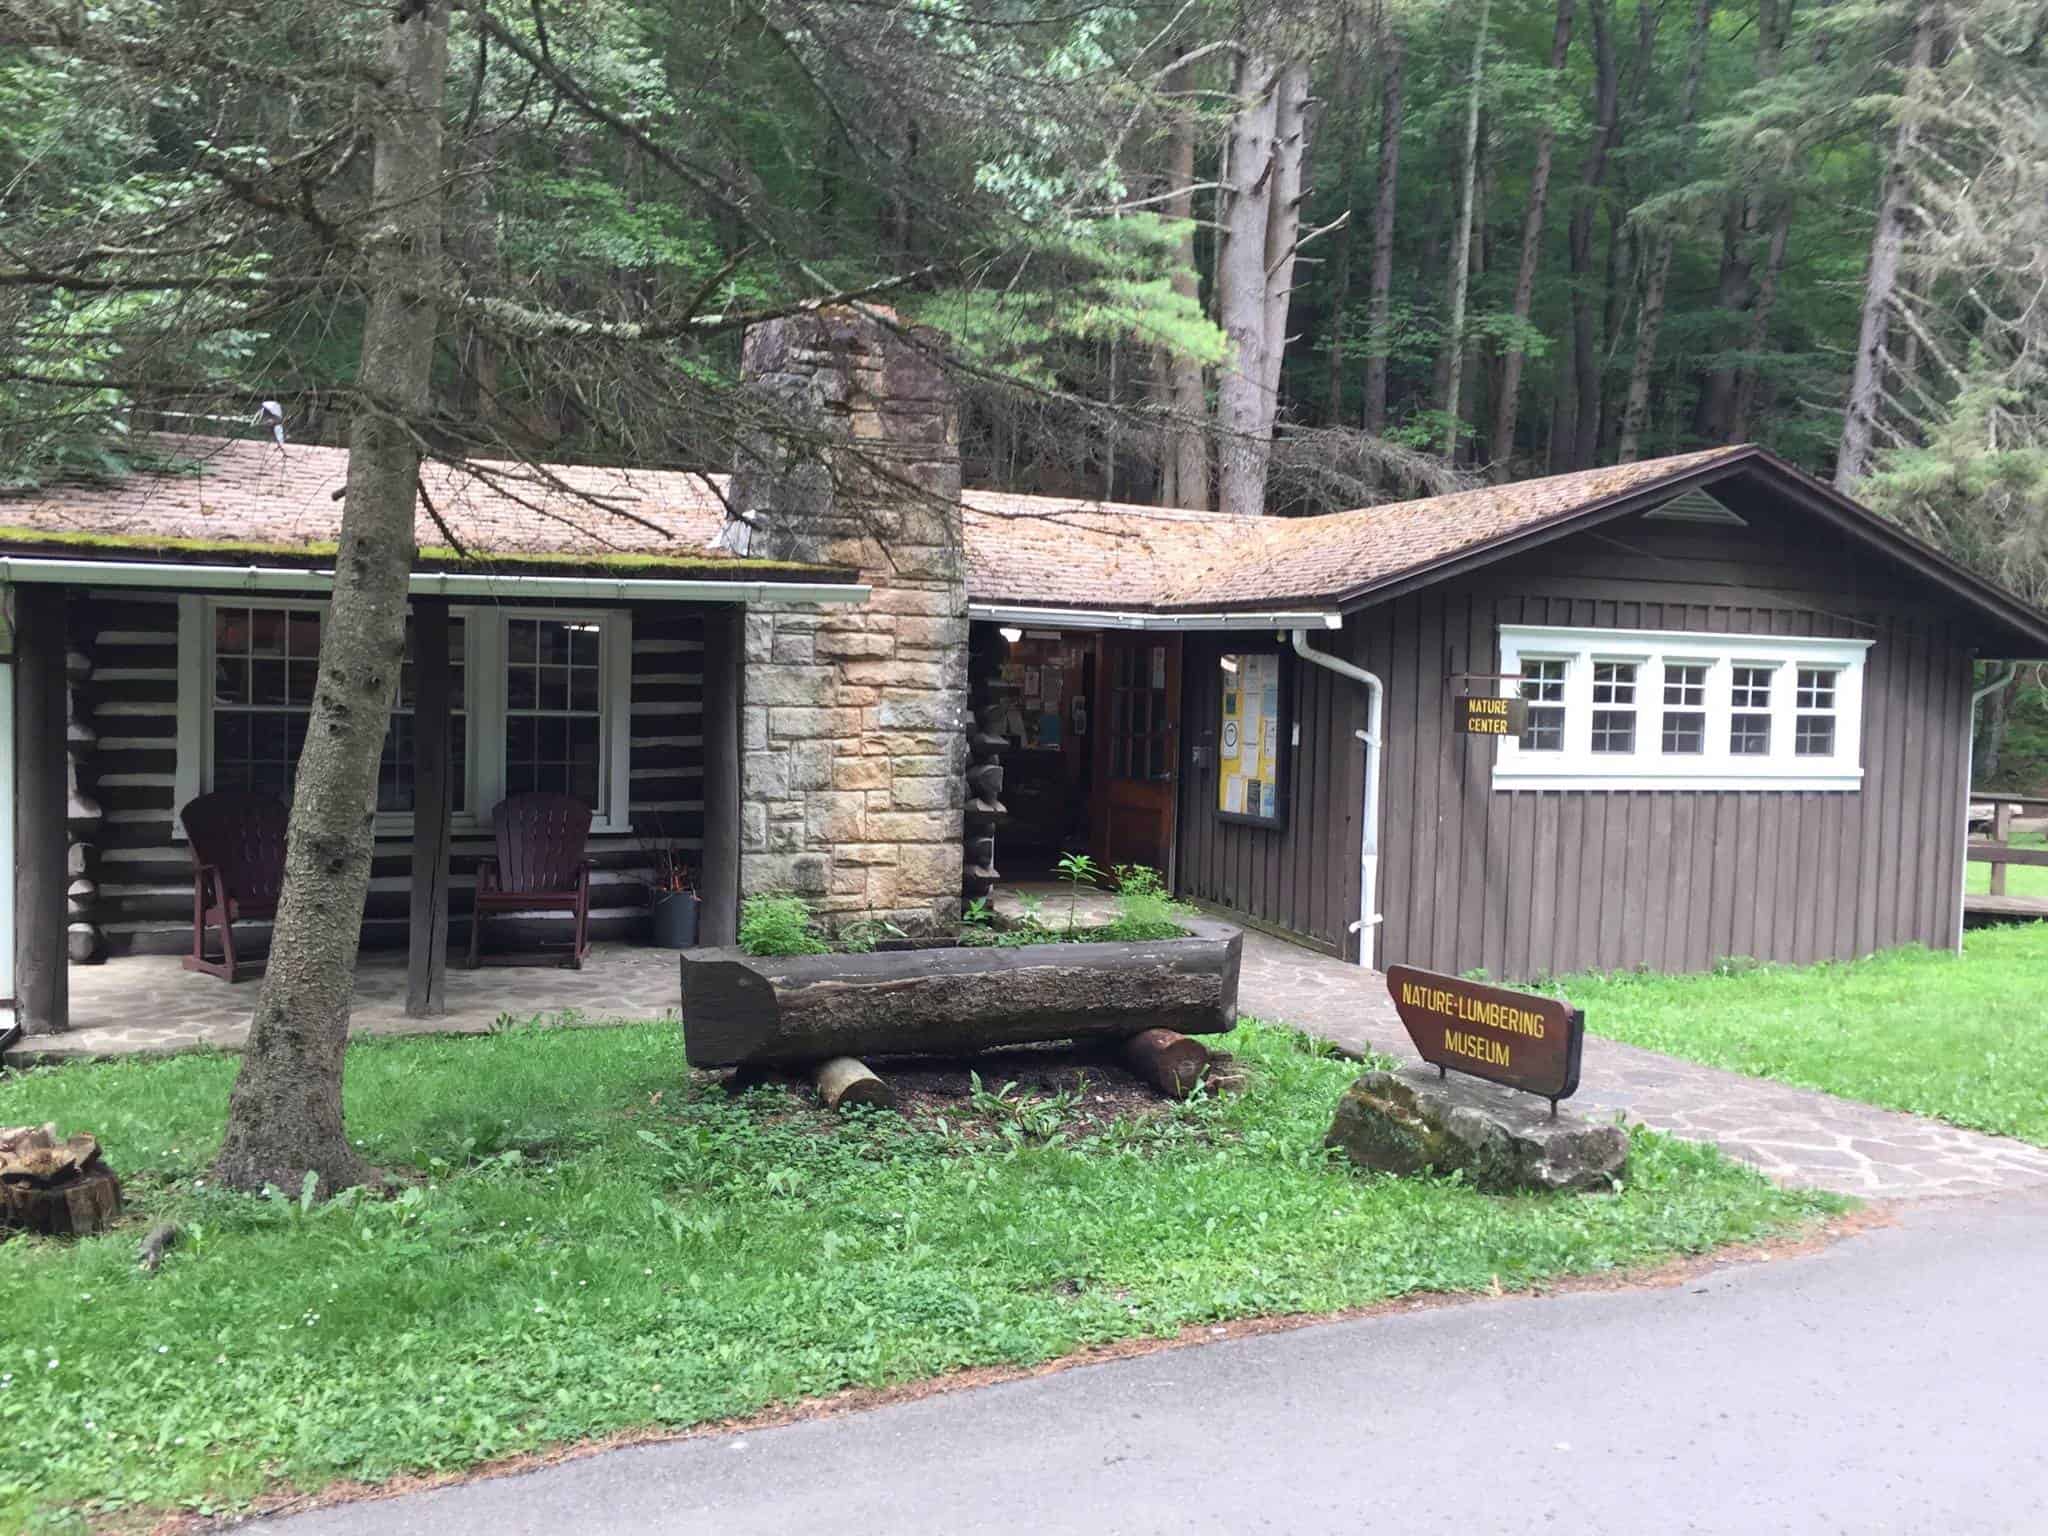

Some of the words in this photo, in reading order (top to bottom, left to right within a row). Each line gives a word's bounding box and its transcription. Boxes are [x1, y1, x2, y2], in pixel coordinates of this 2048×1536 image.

[1468, 699, 1508, 714] NATURE
[1468, 718, 1508, 733] CENTER
[1402, 983, 1544, 1038] NATURE-LUMBERING
[1445, 1029, 1509, 1066] MUSEUM
